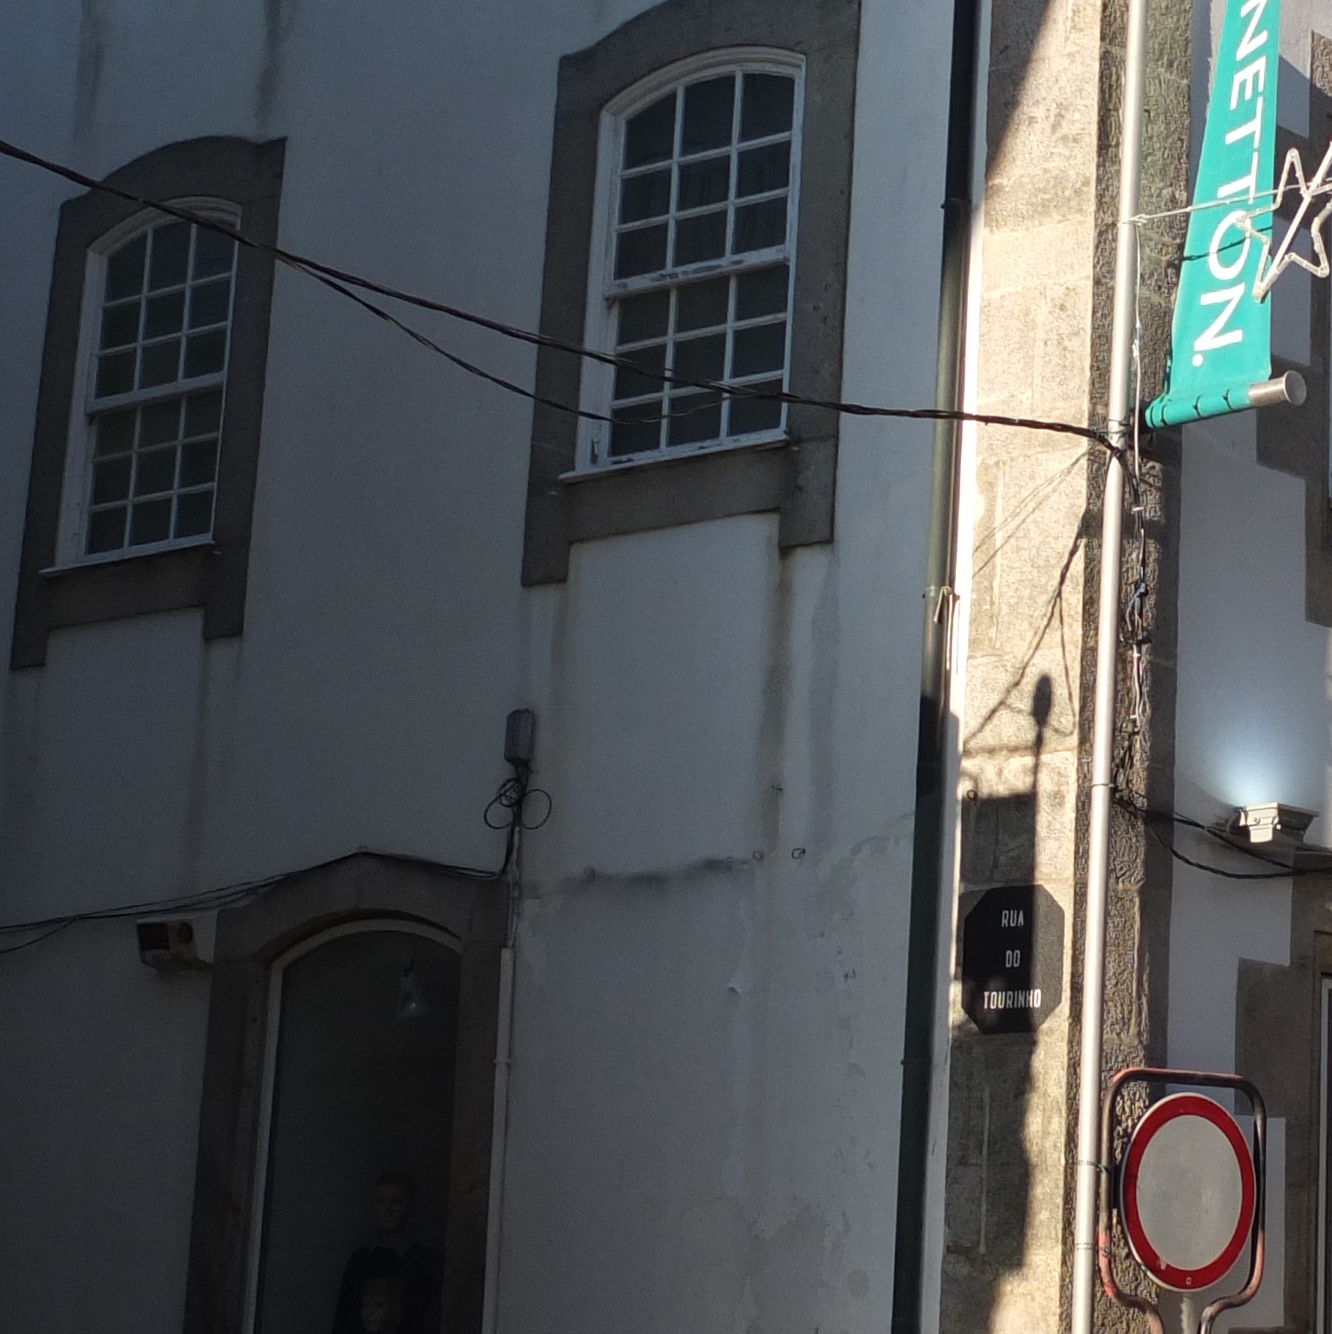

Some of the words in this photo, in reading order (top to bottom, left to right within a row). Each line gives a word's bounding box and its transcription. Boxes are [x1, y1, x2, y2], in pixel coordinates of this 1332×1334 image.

[1001, 909, 1024, 928] RUA
[1005, 950, 1021, 968] DO
[984, 988, 1042, 1009] TOURINHO
